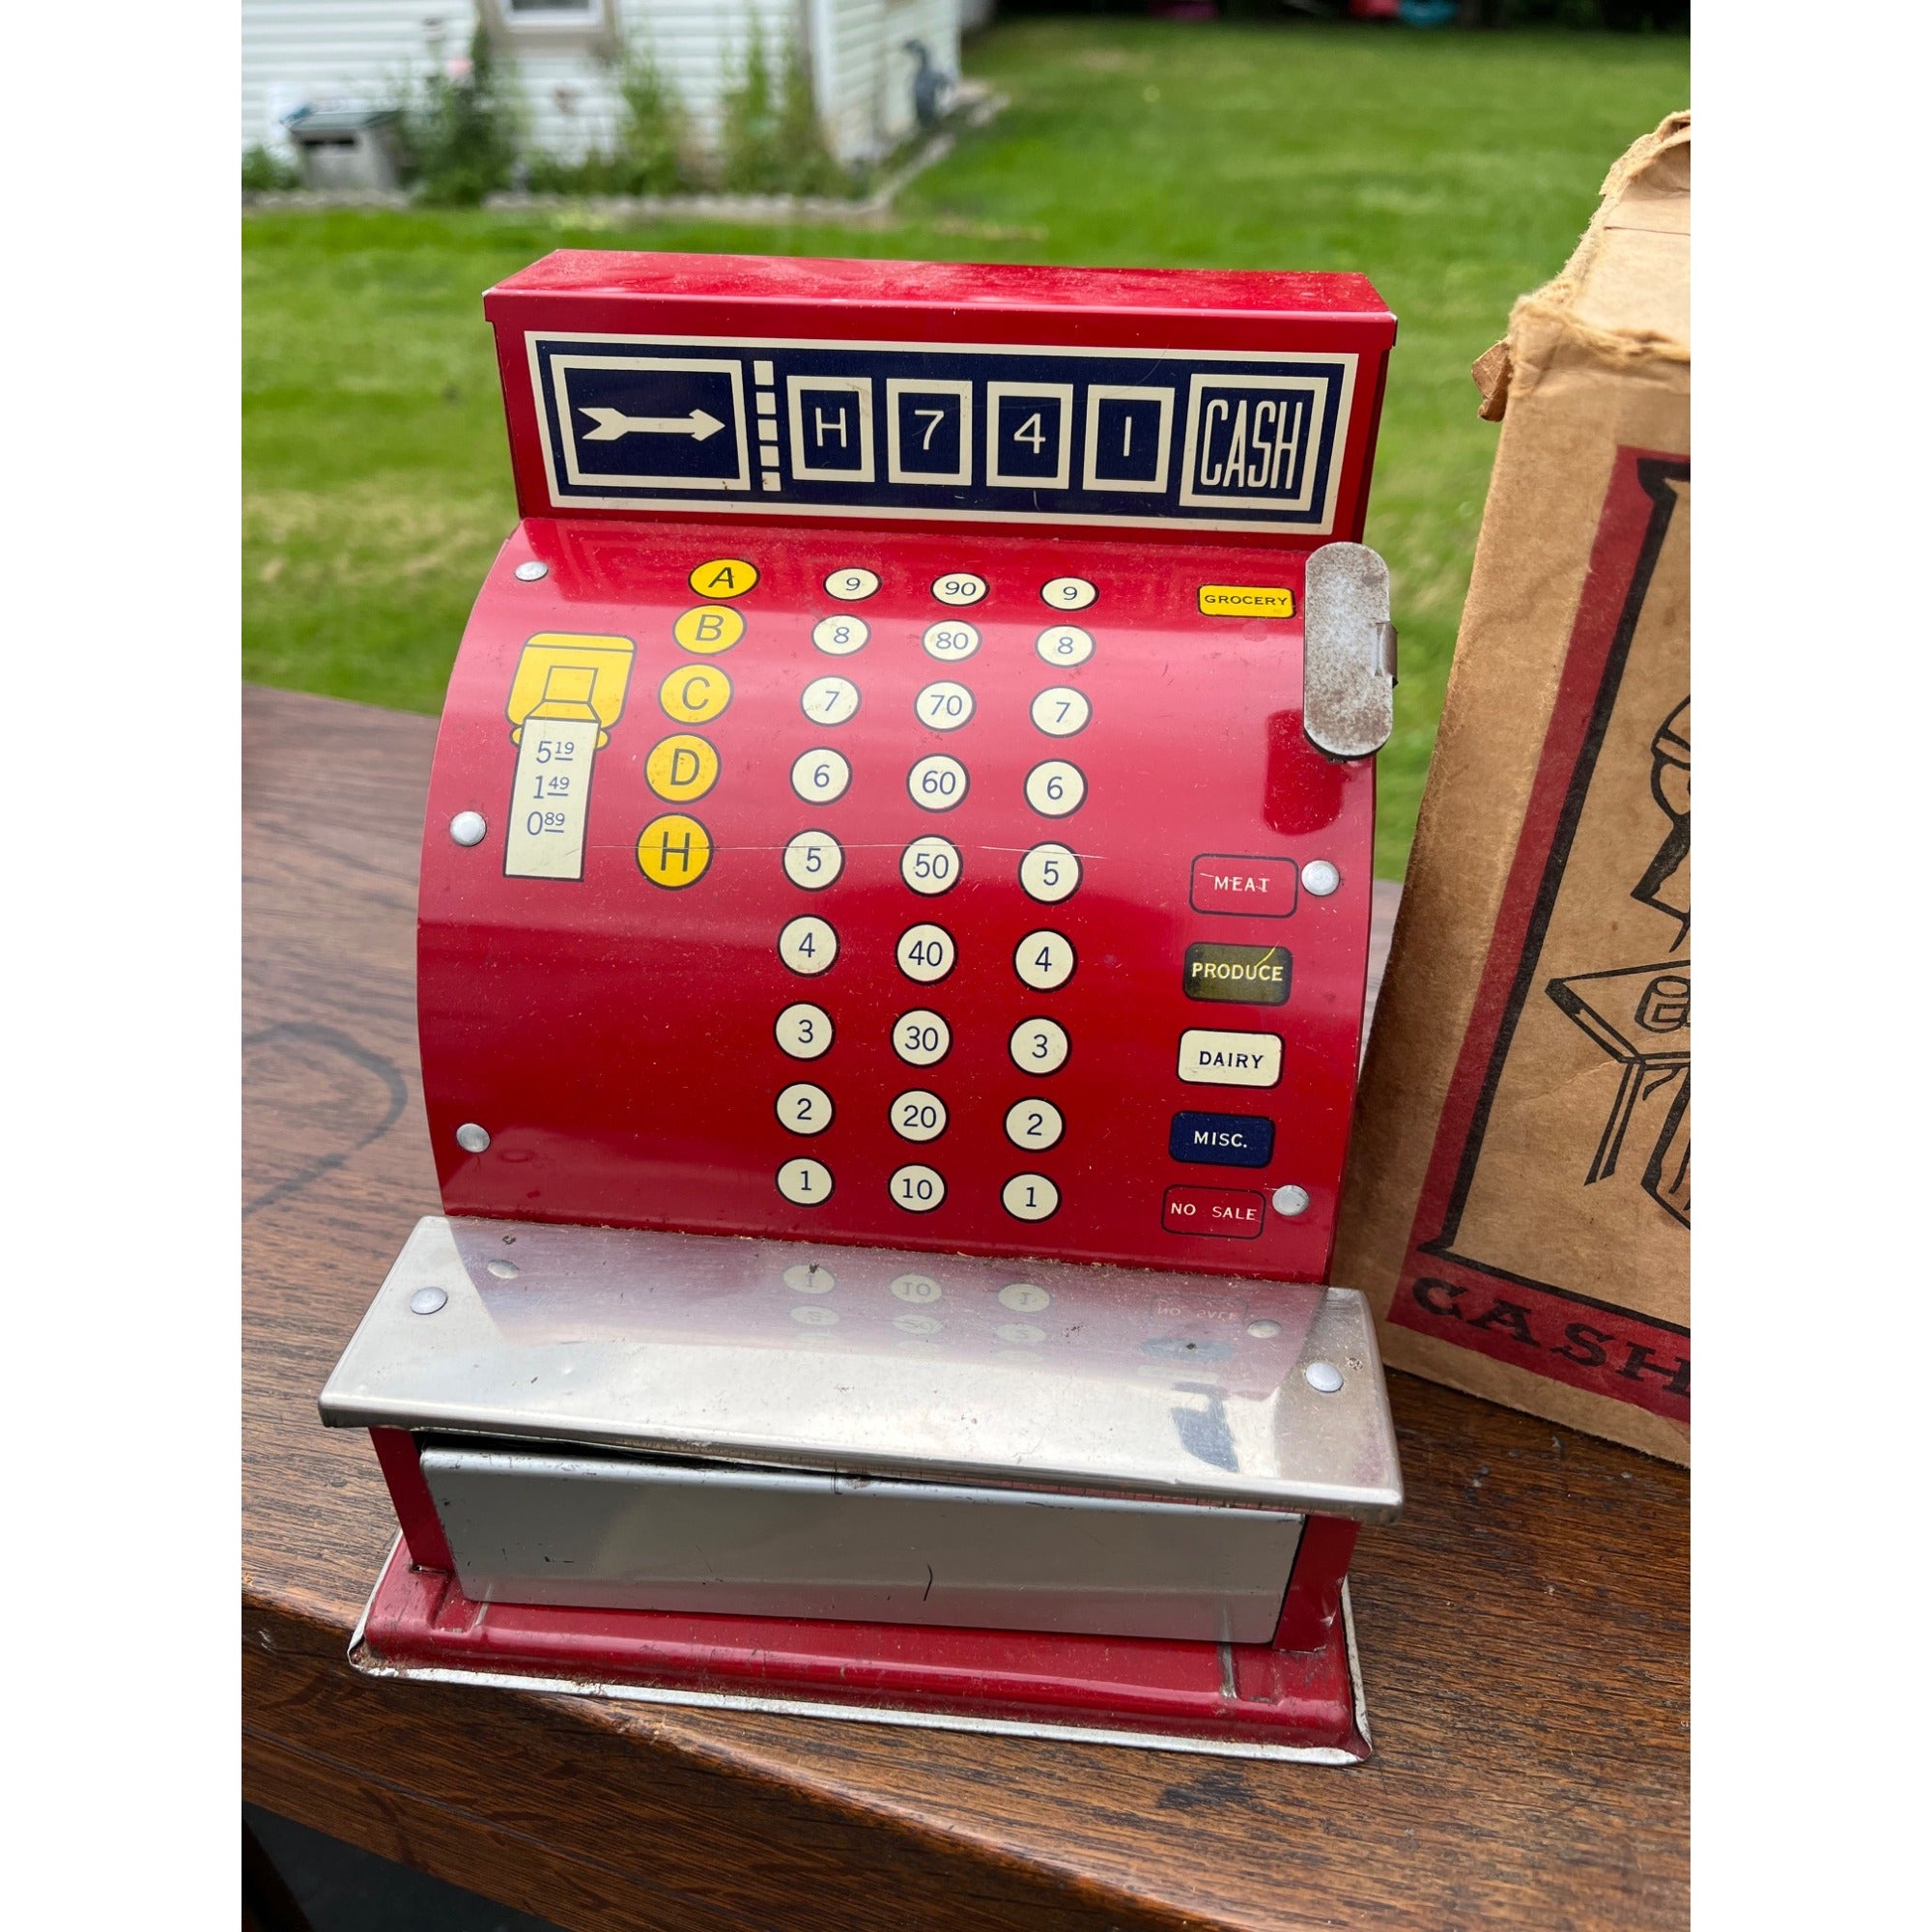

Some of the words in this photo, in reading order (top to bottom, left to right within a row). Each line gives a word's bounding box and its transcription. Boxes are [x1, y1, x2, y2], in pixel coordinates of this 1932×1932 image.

[815, 407, 847, 448] H
[914, 409, 945, 450] 7
[1013, 412, 1046, 454] 4
[1200, 398, 1303, 490] CASH
[708, 567, 734, 588] A
[845, 577, 862, 592] 9
[945, 581, 977, 597] 90
[1063, 585, 1078, 601] 9
[1204, 594, 1288, 606] GROCERY
[695, 613, 724, 641] B
[833, 626, 850, 644] 8
[935, 632, 969, 650] 80
[1057, 637, 1074, 655] 8
[682, 676, 711, 711] C
[824, 690, 840, 712] 7
[930, 695, 963, 717] 70
[1056, 701, 1071, 724] 7
[669, 748, 700, 786] D
[813, 763, 831, 788] 6
[922, 770, 956, 795] 60
[1046, 776, 1064, 801] 6
[660, 831, 691, 873] H
[805, 846, 822, 873] 5
[914, 852, 950, 880] 50
[1042, 860, 1060, 887] 5
[1214, 875, 1270, 893] MEAT
[798, 931, 816, 959] 4
[907, 939, 944, 967] 40
[1034, 946, 1053, 973] 4
[1191, 962, 1284, 981] PRODUCE
[797, 1018, 814, 1044] 3
[904, 1025, 939, 1052] 30
[1031, 1033, 1048, 1060] 3
[1199, 1050, 1264, 1069] DAIRY
[796, 1097, 812, 1122] 2
[902, 1104, 937, 1129] 20
[1026, 1112, 1043, 1137] 2
[1194, 1130, 1248, 1149] MISC.
[800, 1169, 812, 1191] 1
[901, 1178, 933, 1201] 10
[1025, 1185, 1037, 1208] 1
[1171, 1202, 1197, 1216] NO
[1211, 1206, 1258, 1221] SALE
[1411, 1277, 1690, 1398] CASH
